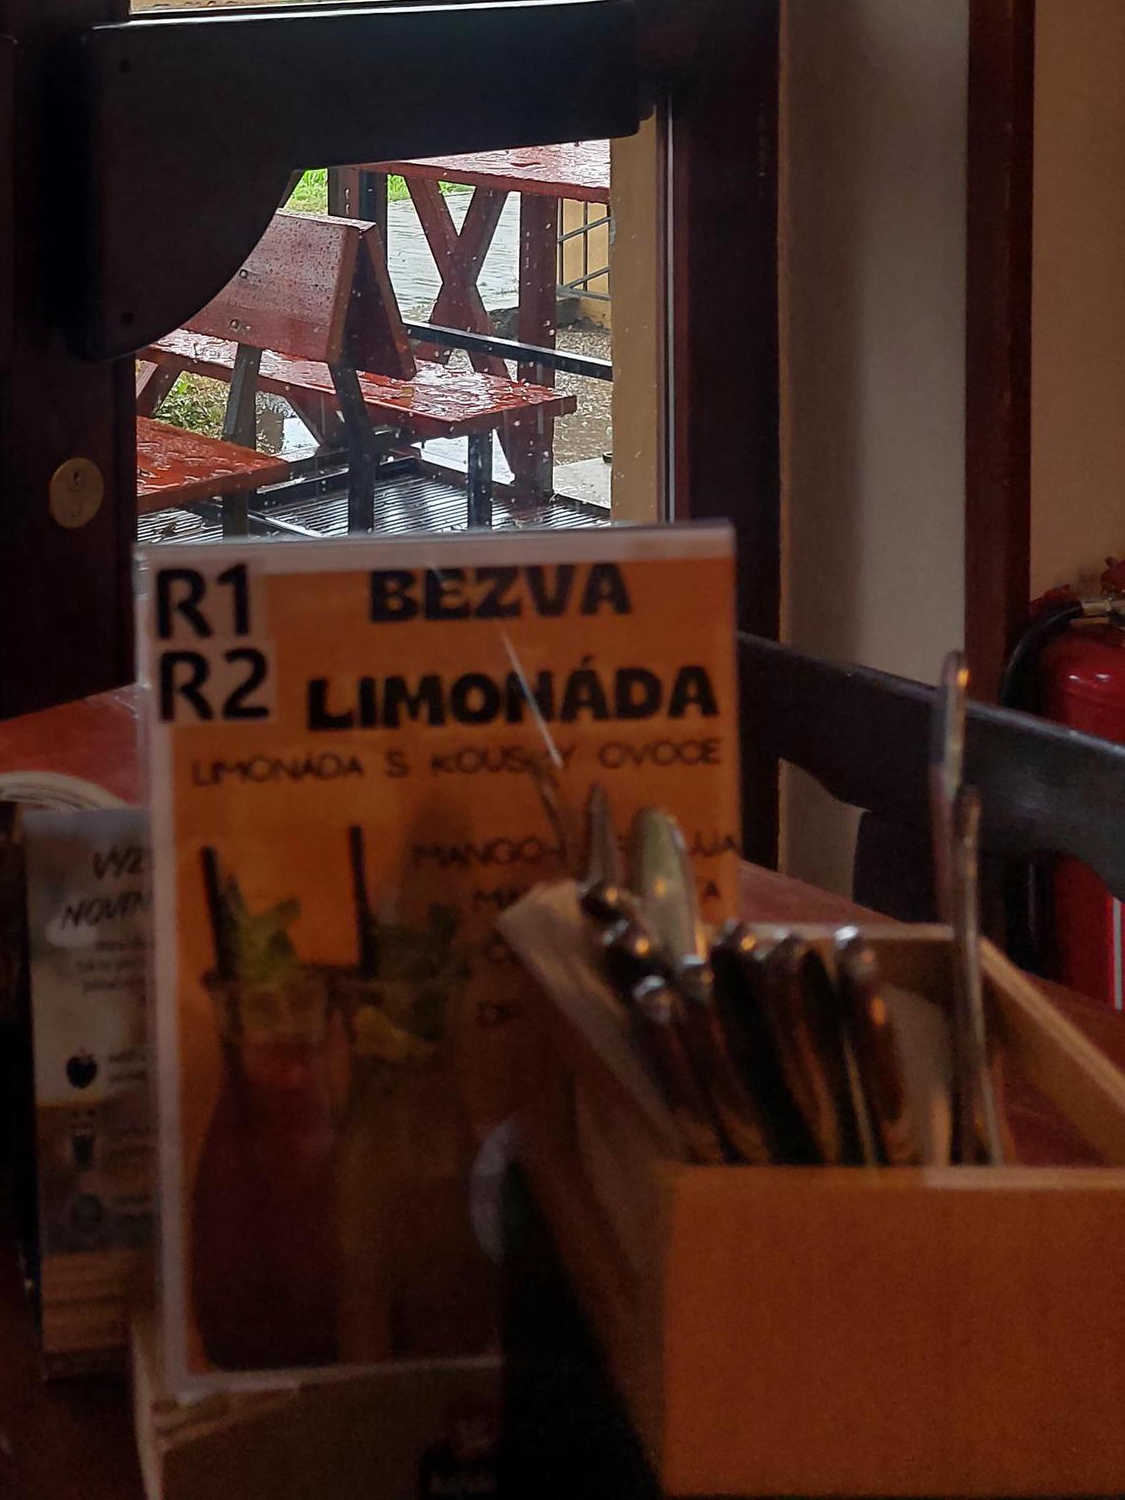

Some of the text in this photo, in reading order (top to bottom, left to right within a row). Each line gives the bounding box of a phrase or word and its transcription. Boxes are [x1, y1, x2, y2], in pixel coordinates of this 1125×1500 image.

[156, 563, 249, 639] R1
[368, 562, 633, 625] BEZVA
[159, 649, 269, 722] R2
[307, 655, 720, 731] LIMONÁDA
[383, 746, 410, 779] S
[598, 737, 723, 770] OVOCE
